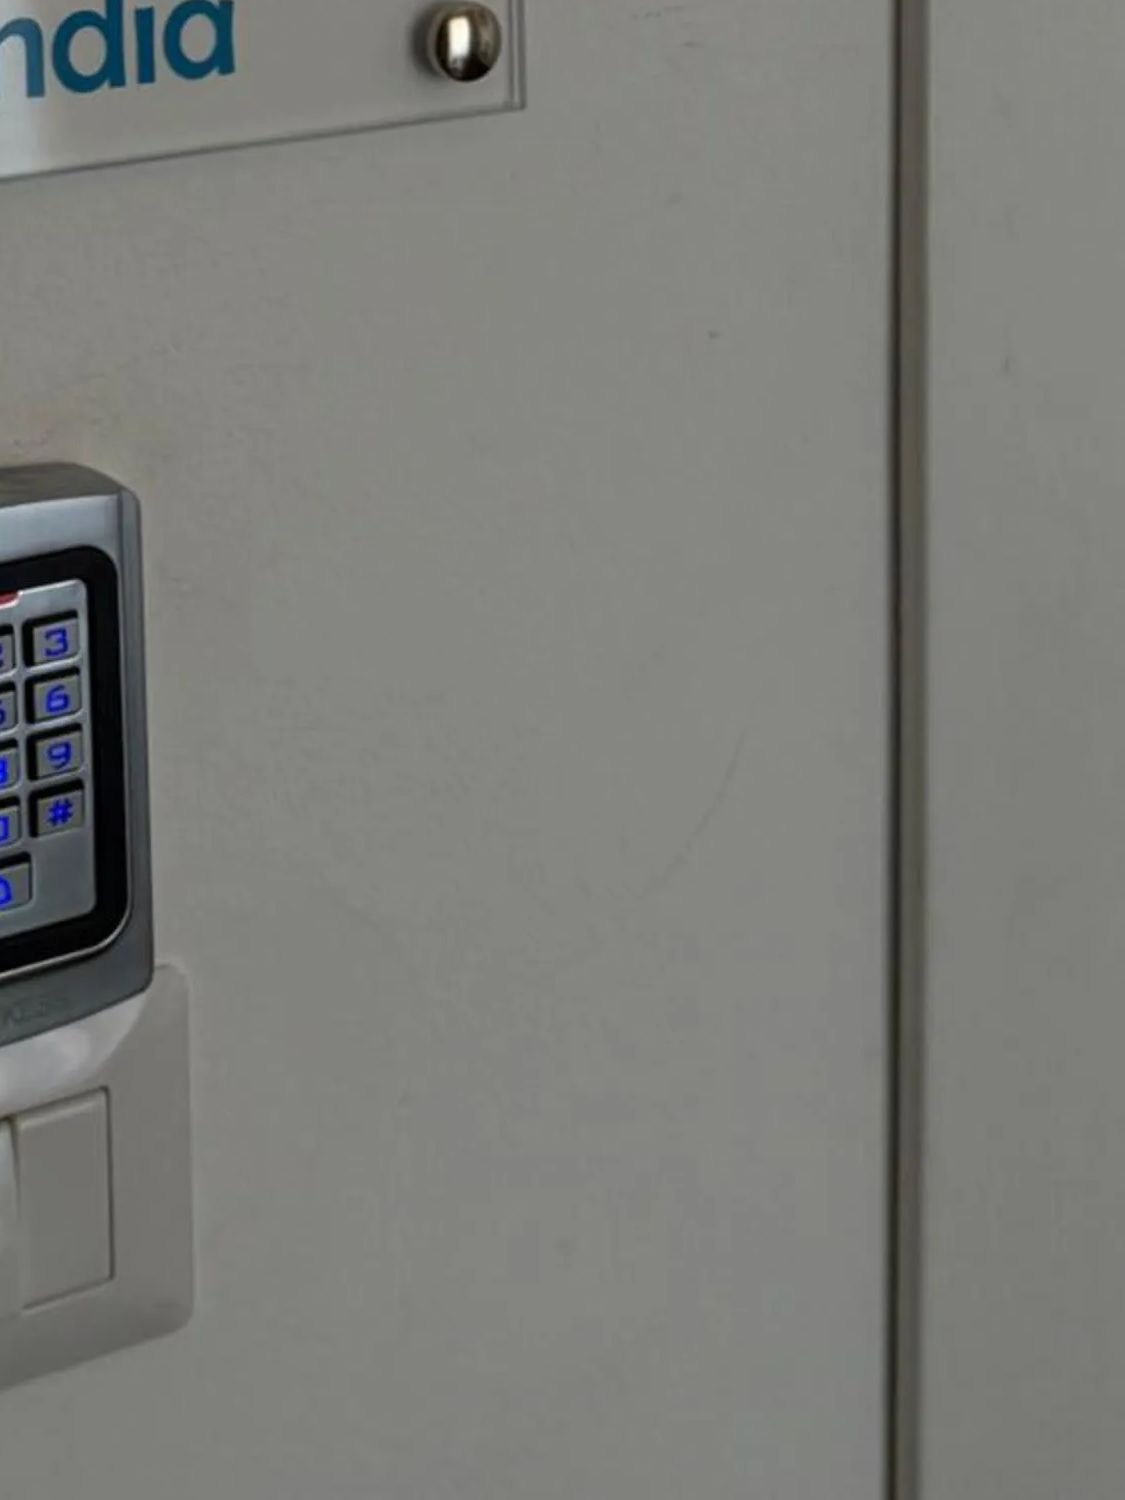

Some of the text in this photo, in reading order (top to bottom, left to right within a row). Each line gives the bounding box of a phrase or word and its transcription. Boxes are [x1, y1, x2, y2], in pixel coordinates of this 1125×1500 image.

[44, 627, 68, 657] 3
[45, 684, 70, 713] 6
[47, 741, 72, 770] 9
